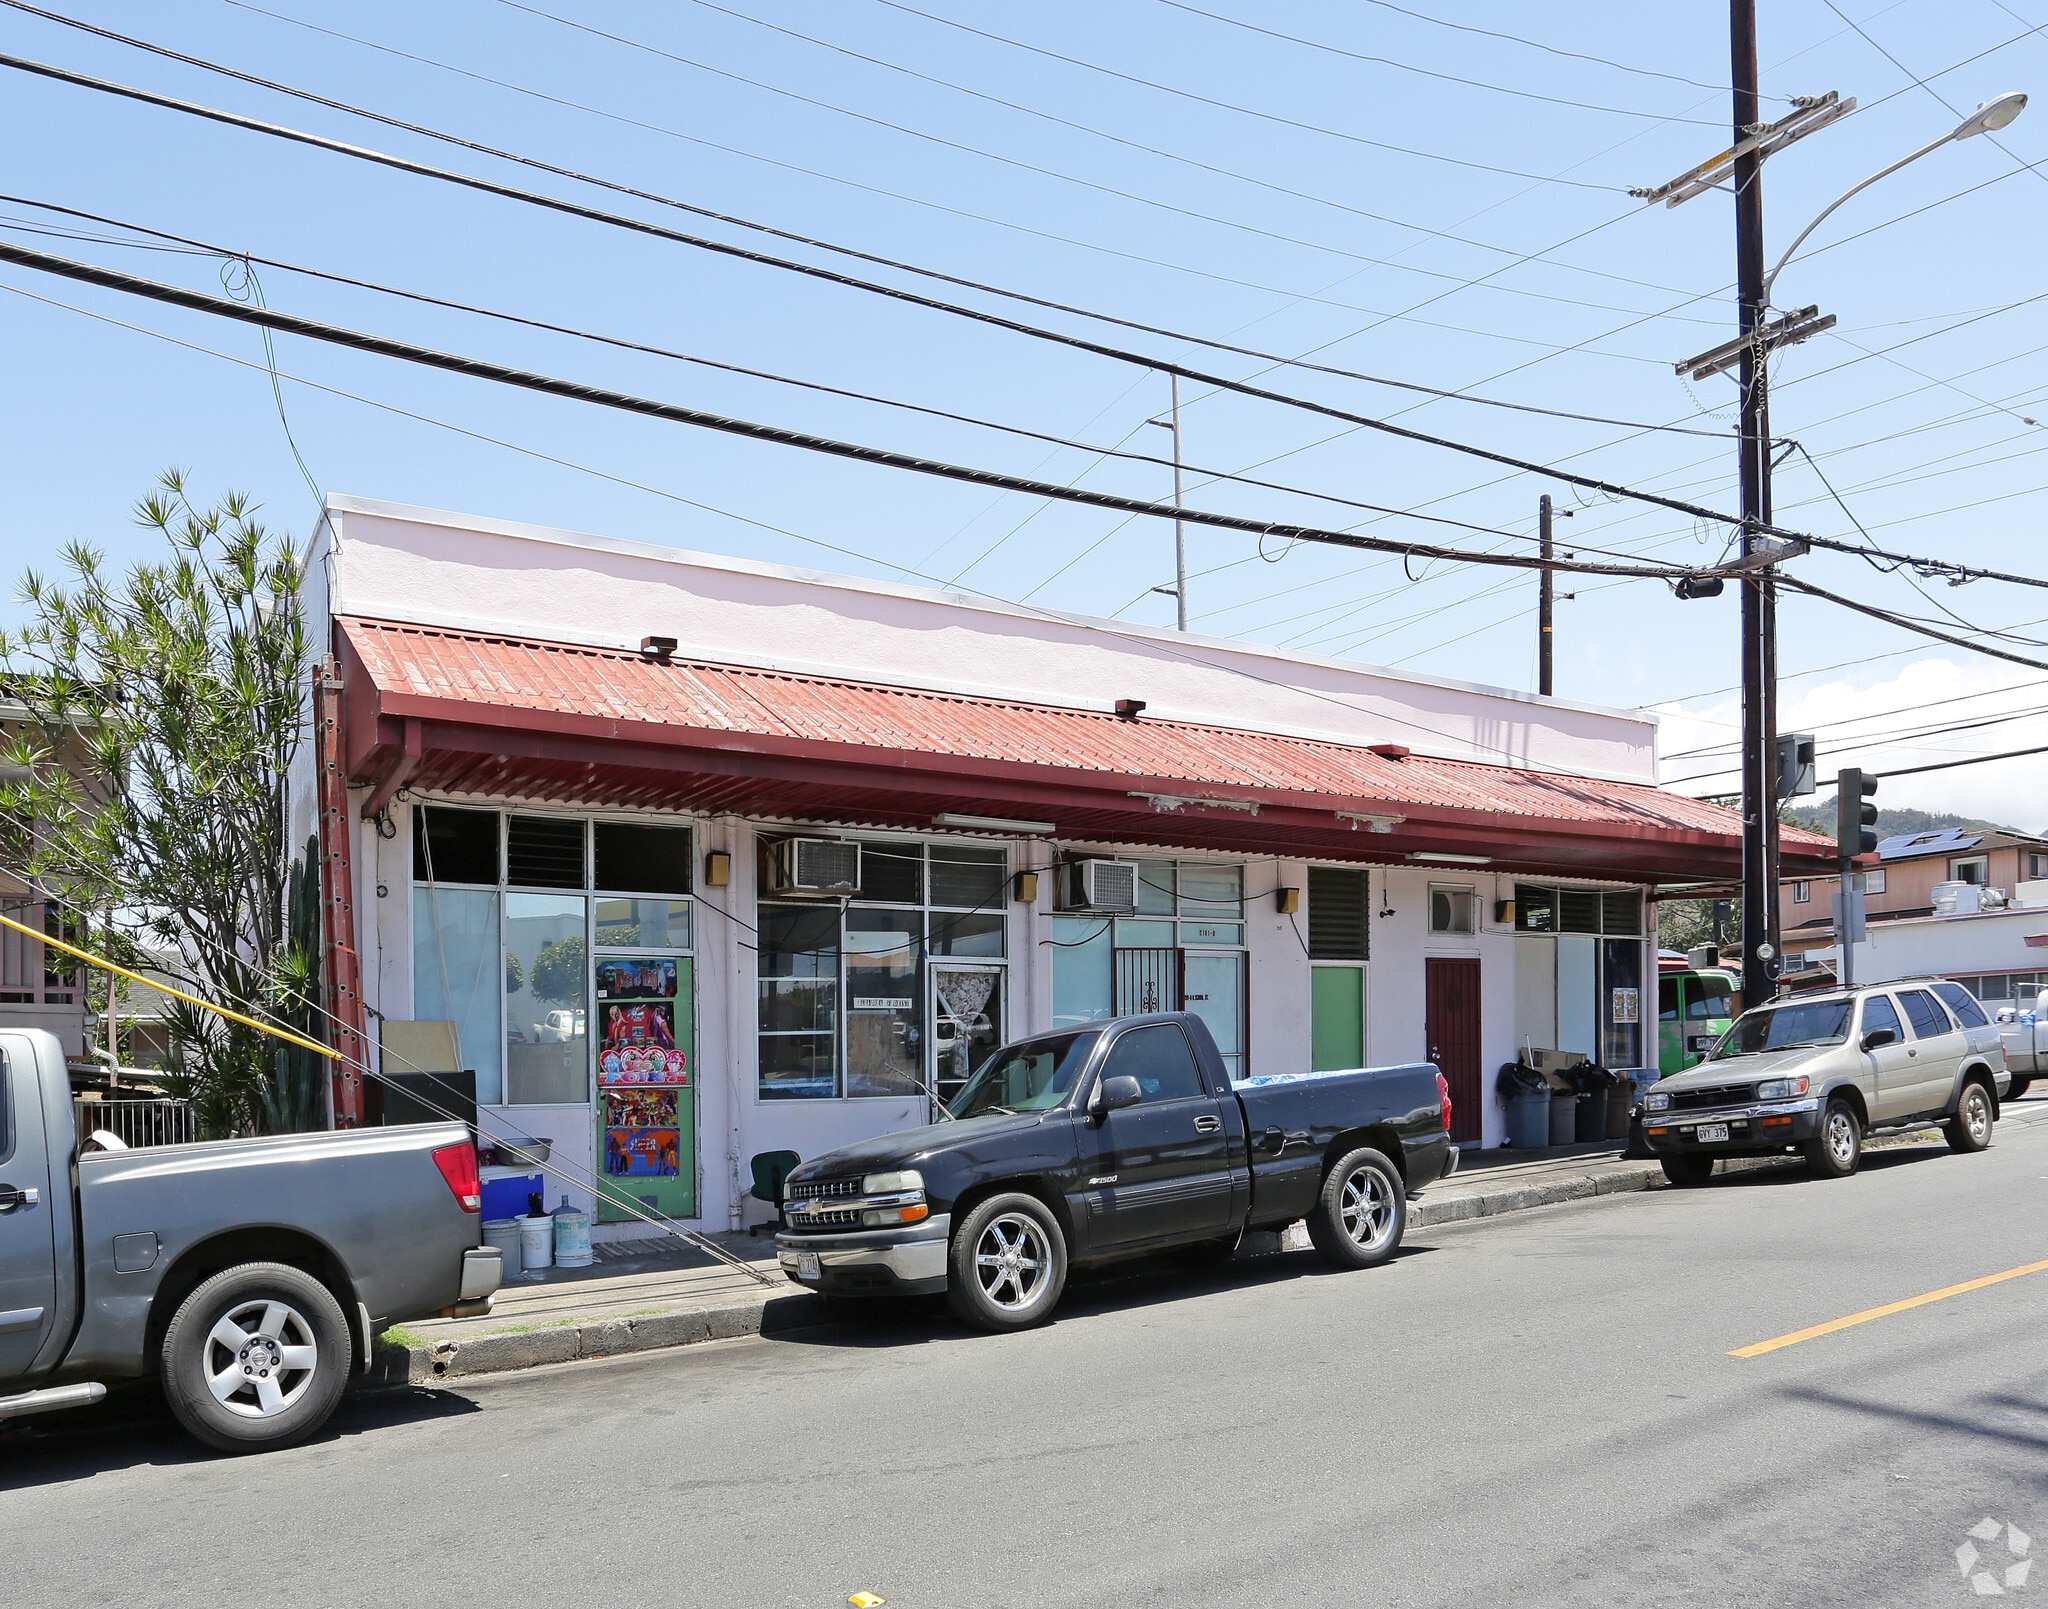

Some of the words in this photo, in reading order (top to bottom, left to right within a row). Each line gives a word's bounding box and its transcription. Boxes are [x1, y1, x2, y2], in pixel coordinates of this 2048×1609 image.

[605, 1071, 681, 1084] POINT
[1698, 1128, 1711, 1139] GVY
[1714, 1127, 1727, 1138] 375
[1099, 1174, 1118, 1184] 1500
